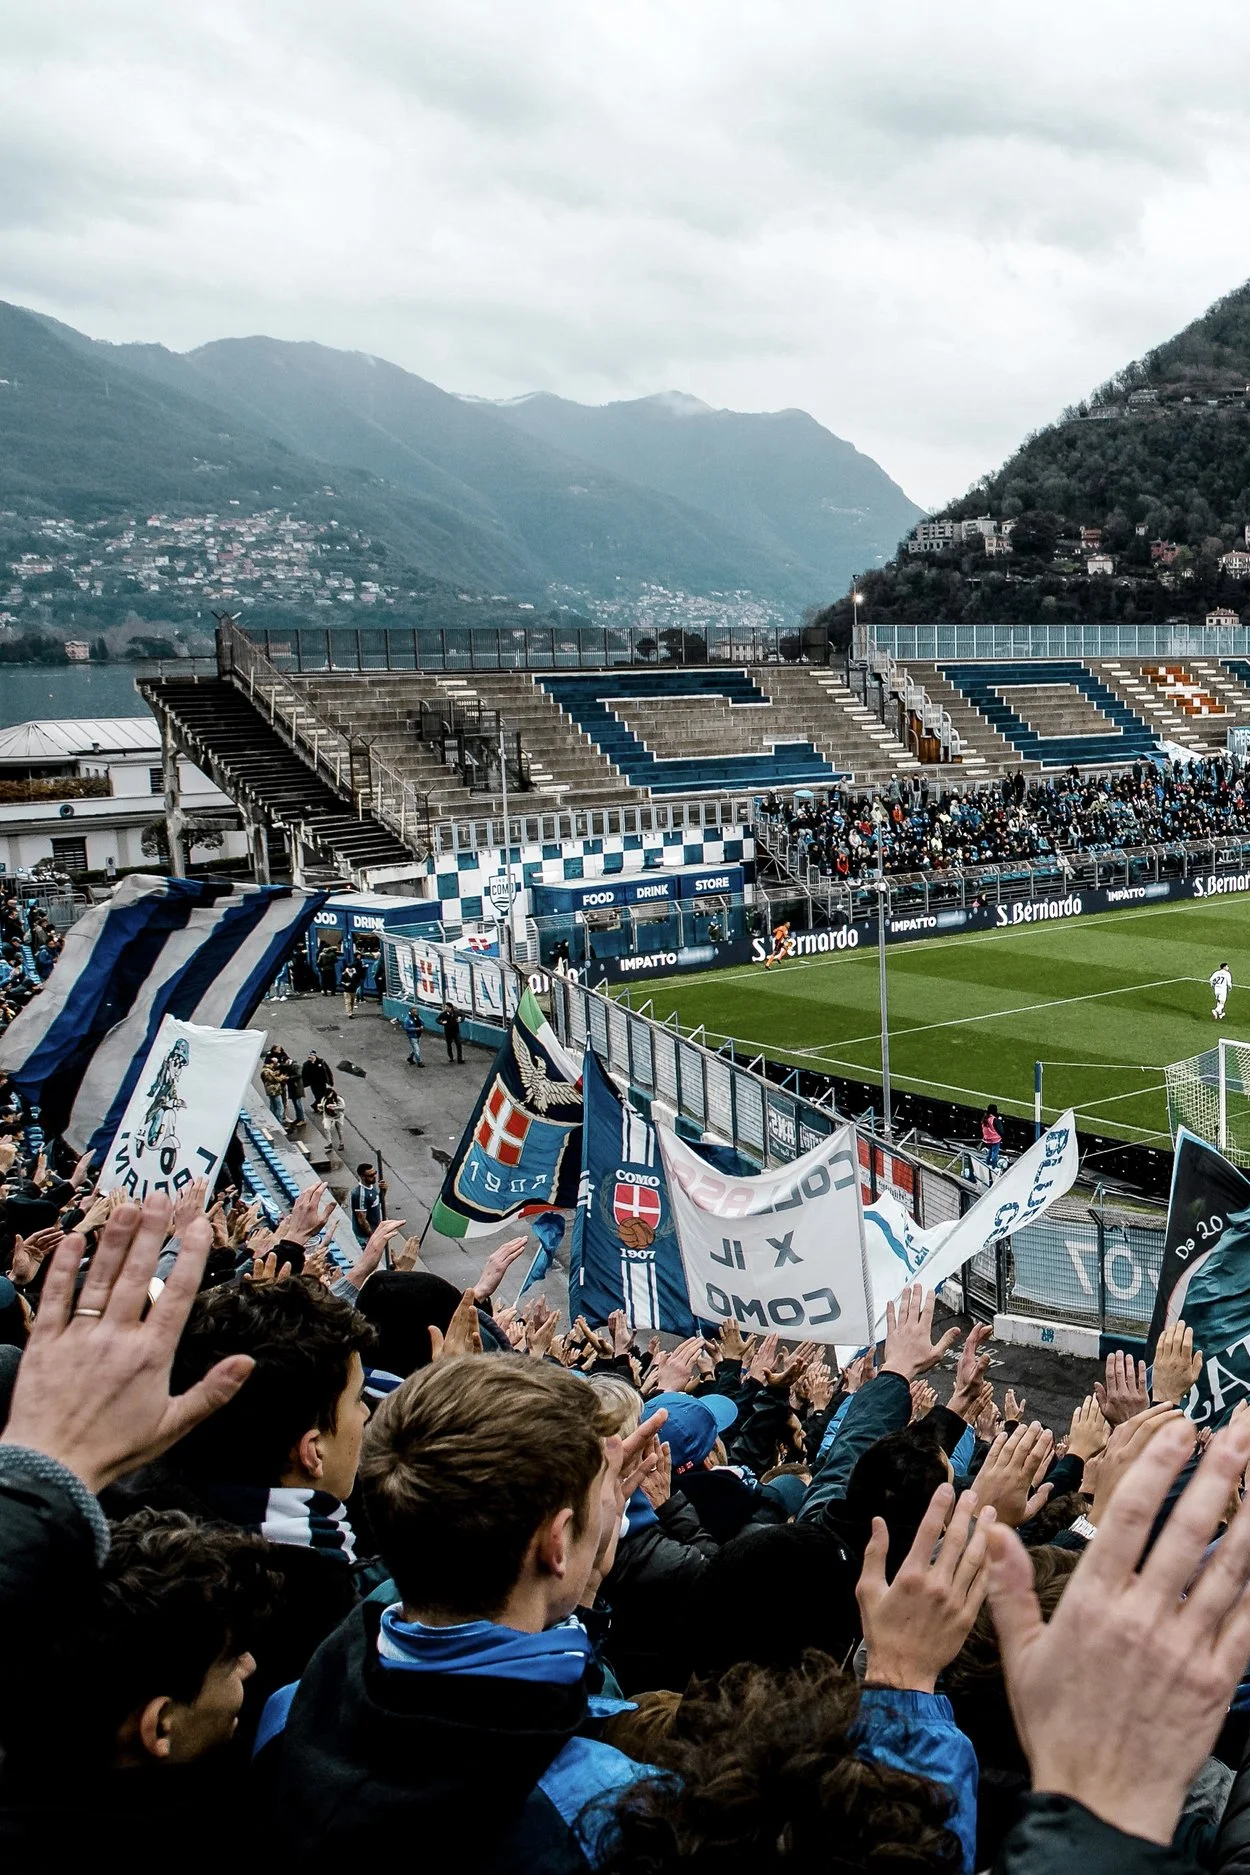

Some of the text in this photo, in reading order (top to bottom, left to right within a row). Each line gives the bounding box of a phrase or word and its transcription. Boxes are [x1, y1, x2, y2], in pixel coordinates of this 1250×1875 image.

[695, 877, 730, 891] STORE
[583, 891, 615, 906] FOOD
[636, 883, 669, 899] DRINK
[1108, 888, 1146, 902] IMPATTO
[996, 894, 1082, 926] S.Bernardo
[313, 912, 386, 930] OOD DRINK
[891, 916, 937, 932] IMPATTO
[752, 924, 859, 962] Sernardo
[620, 952, 677, 972] IMPATTO
[469, 1160, 547, 1194] 1907
[615, 1169, 661, 1187] COMO
[620, 1247, 657, 1260] 1907
